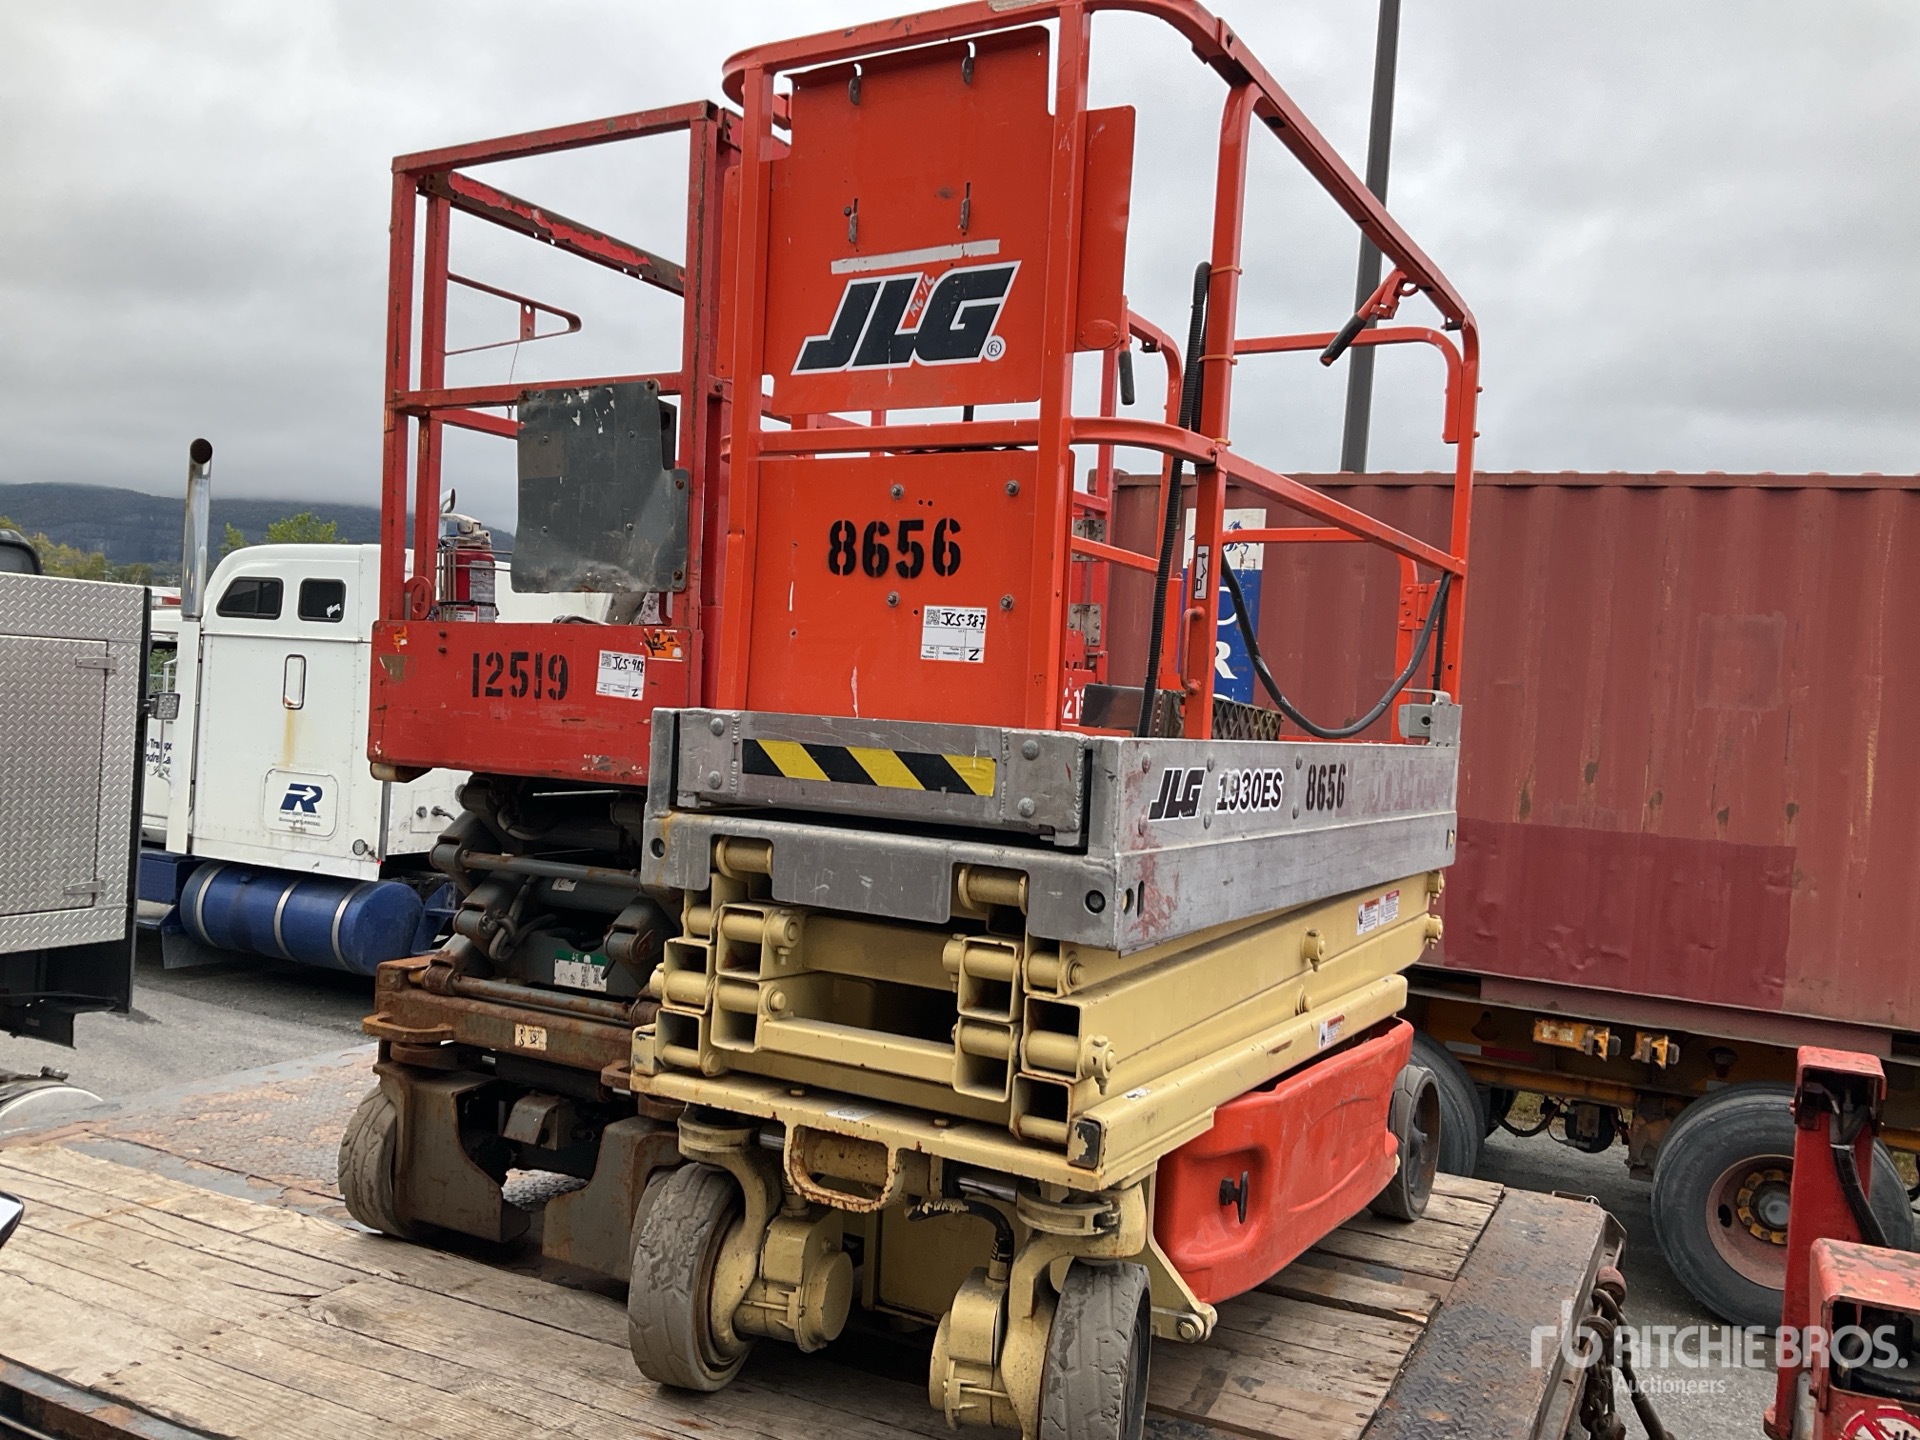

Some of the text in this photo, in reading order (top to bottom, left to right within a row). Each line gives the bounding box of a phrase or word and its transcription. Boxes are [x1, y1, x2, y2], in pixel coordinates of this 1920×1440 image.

[791, 261, 1021, 376] JLG
[828, 518, 961, 579] 8656
[471, 651, 568, 701] 12519
[1148, 767, 1205, 821] JLG
[1215, 768, 1283, 814] 1930ES
[1305, 763, 1346, 810] 8656
